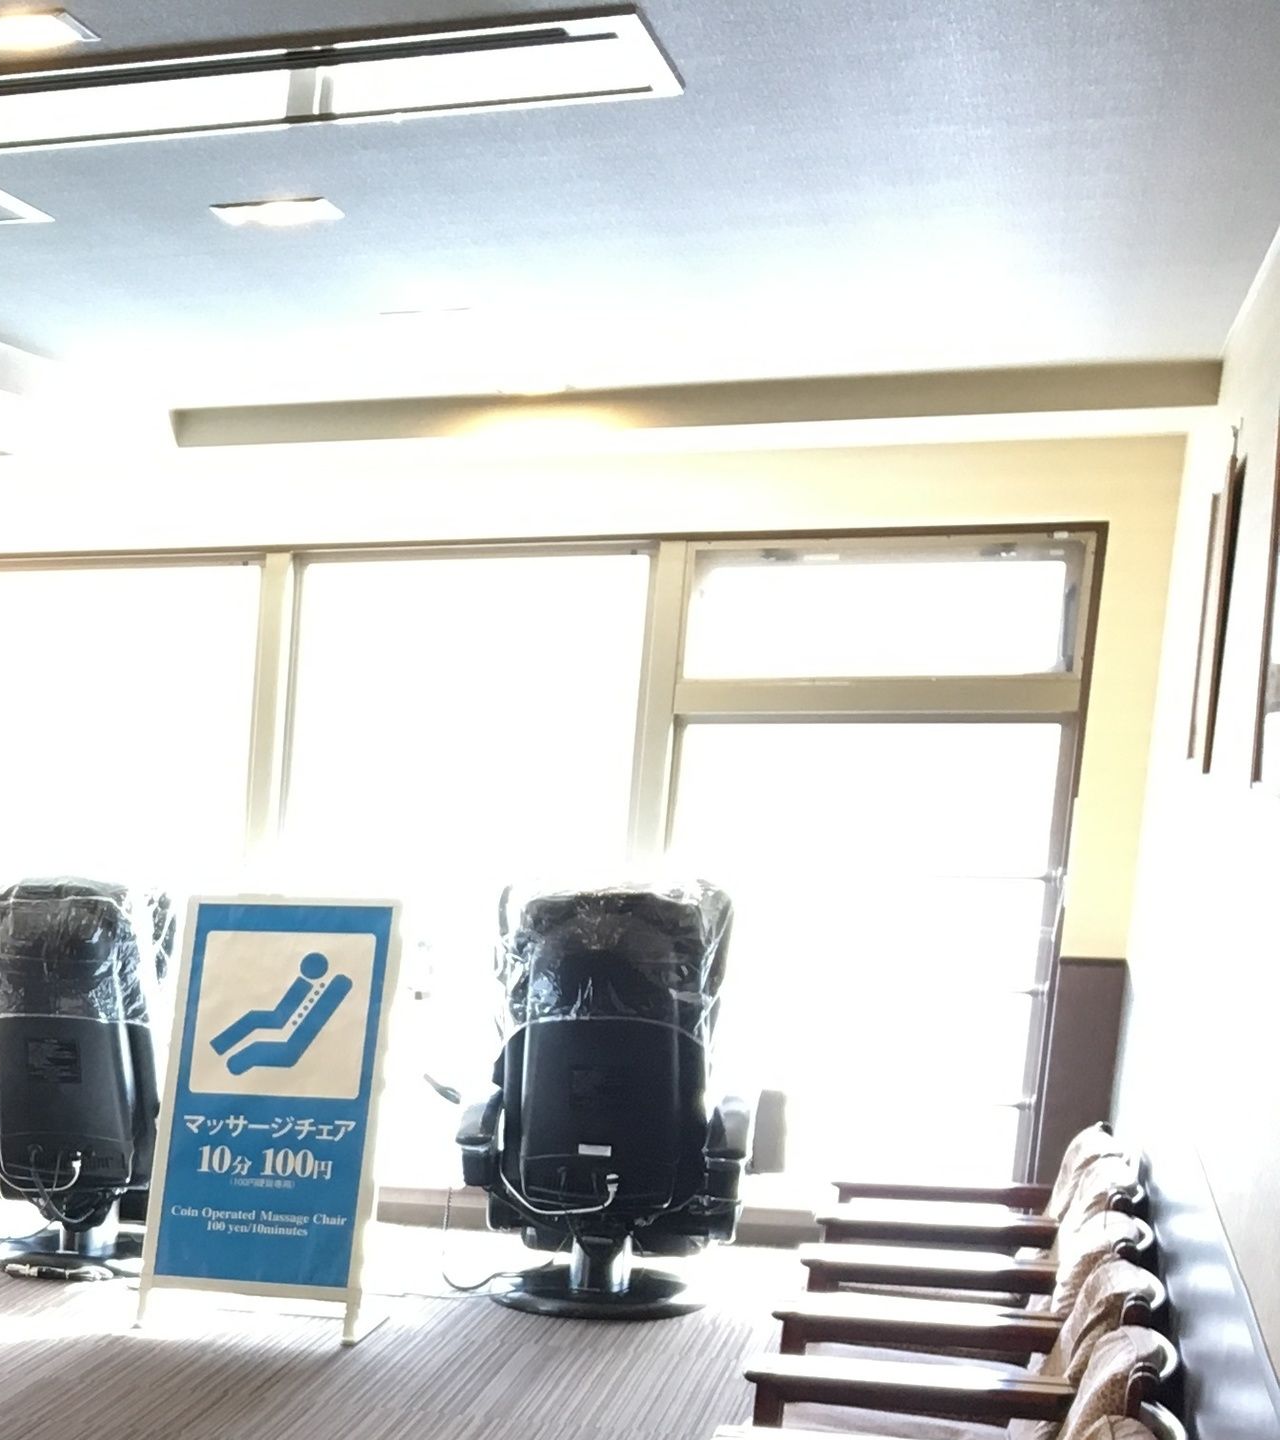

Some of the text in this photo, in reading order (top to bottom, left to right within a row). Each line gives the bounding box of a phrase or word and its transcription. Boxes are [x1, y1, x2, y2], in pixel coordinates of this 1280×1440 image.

[183, 1114, 357, 1142] マッサージチェア
[197, 1145, 334, 1180] 10分 100円
[171, 1204, 348, 1226] Coin Operated Massage Chair
[206, 1220, 308, 1237] 100 yen/10minutes
